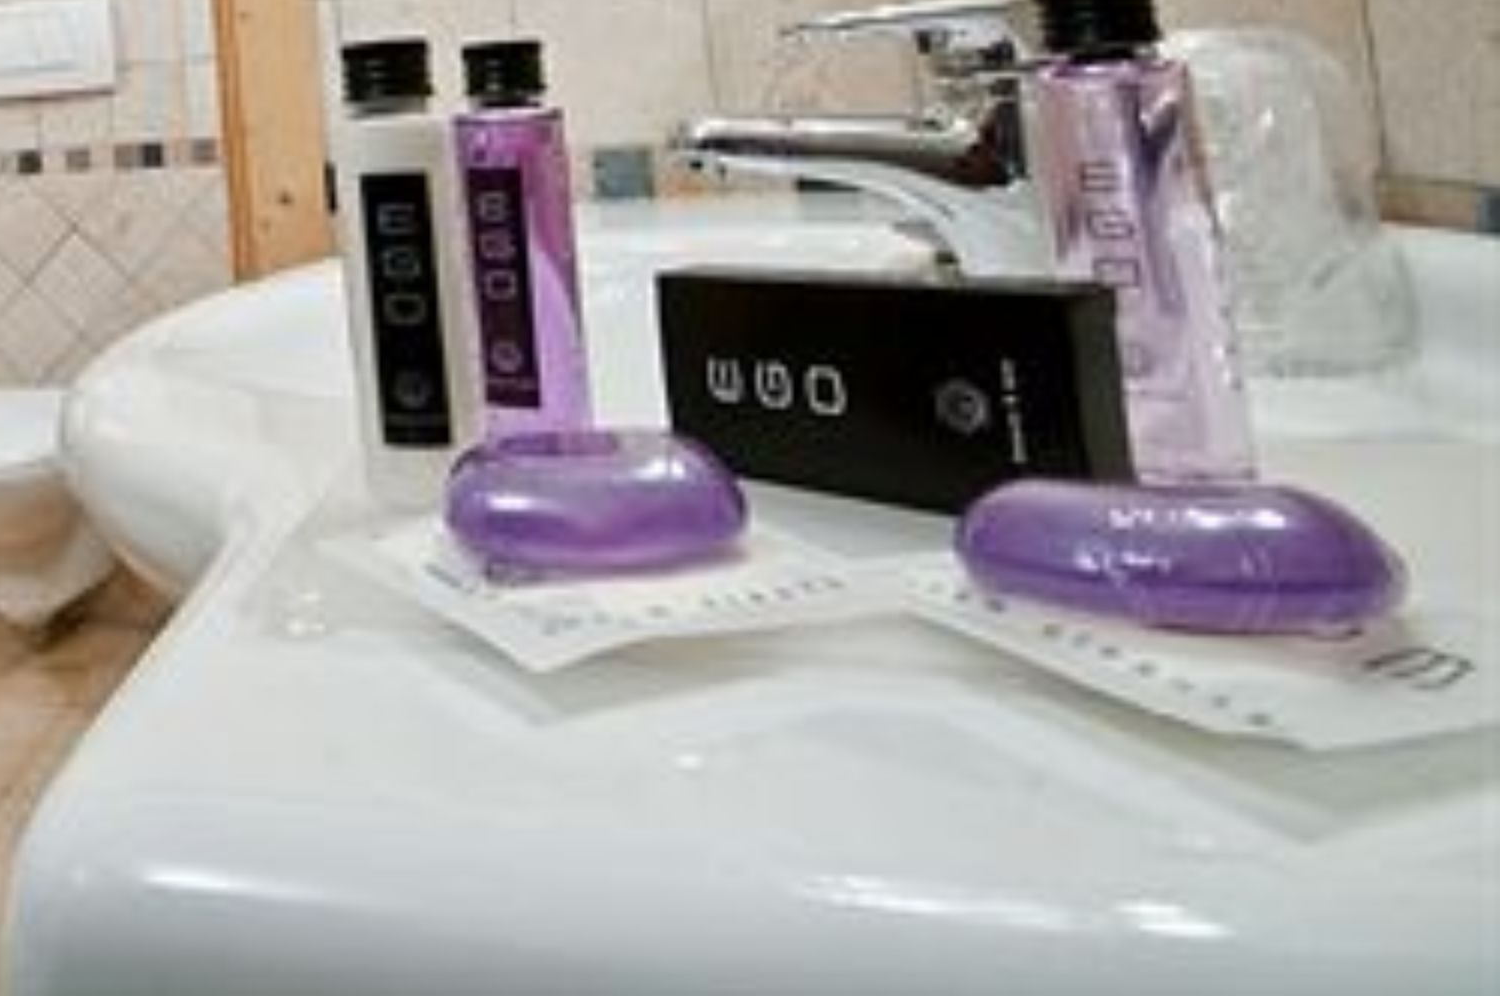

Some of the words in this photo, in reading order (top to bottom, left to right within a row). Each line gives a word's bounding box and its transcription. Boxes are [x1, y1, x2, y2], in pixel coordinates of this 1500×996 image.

[377, 203, 428, 326] EGO
[477, 191, 519, 301] EGO
[705, 356, 849, 416] EGO
